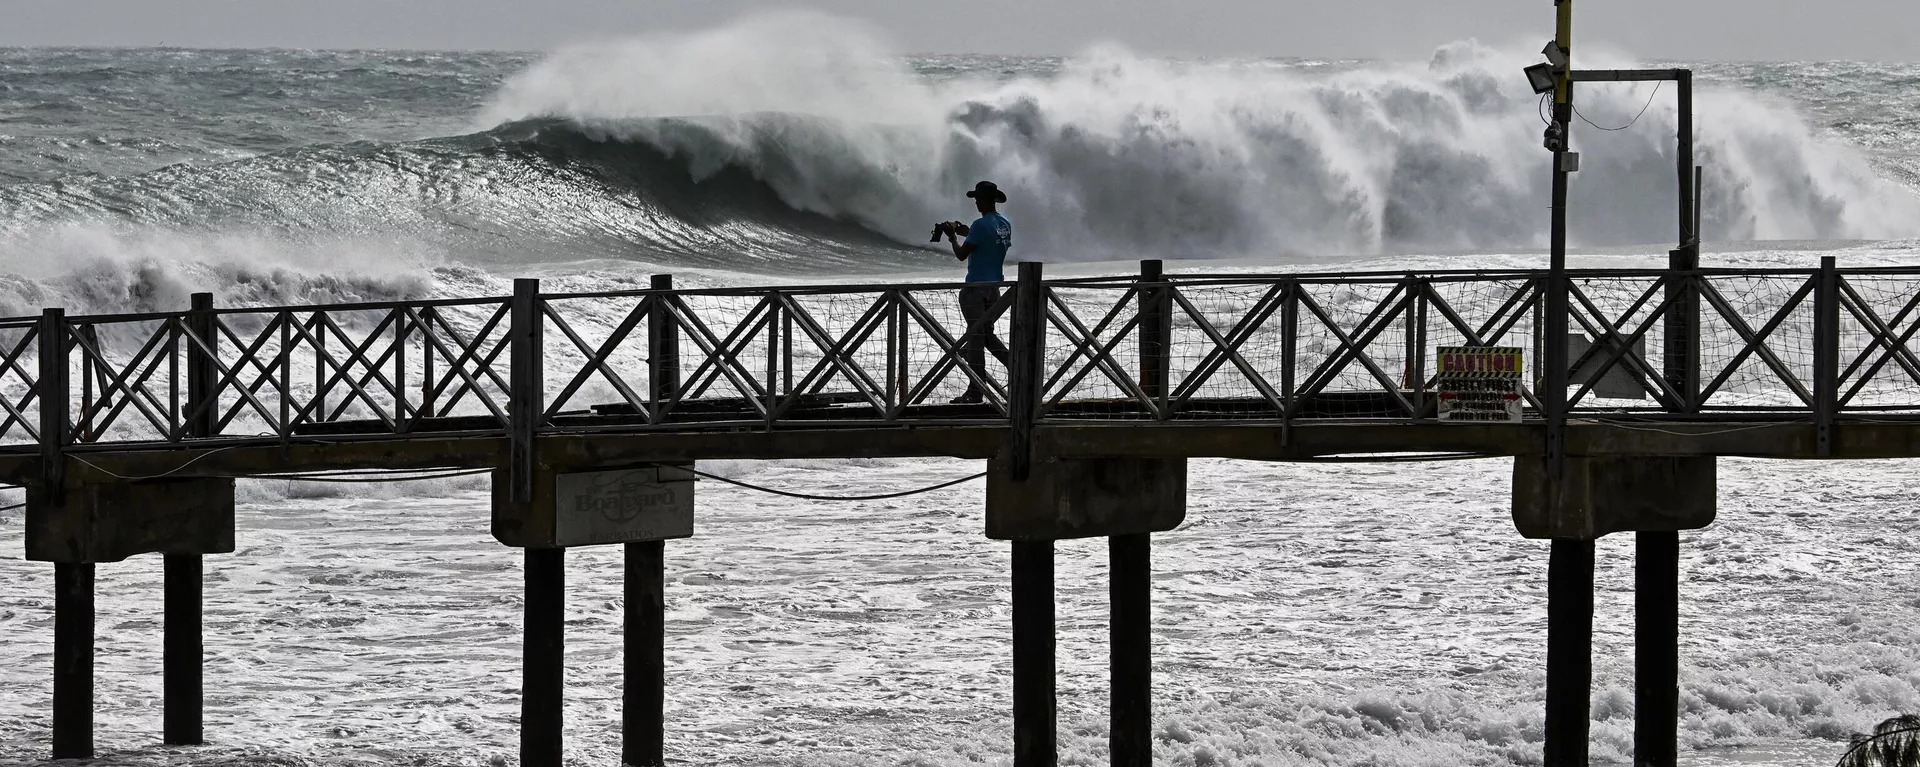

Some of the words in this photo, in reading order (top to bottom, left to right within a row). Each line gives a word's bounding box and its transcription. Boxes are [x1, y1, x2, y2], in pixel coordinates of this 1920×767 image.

[1443, 353, 1515, 372] CAUTION
[1442, 379, 1482, 391] SAFETY
[1485, 380, 1517, 391] FIRST
[590, 529, 654, 541] BARBADOS
